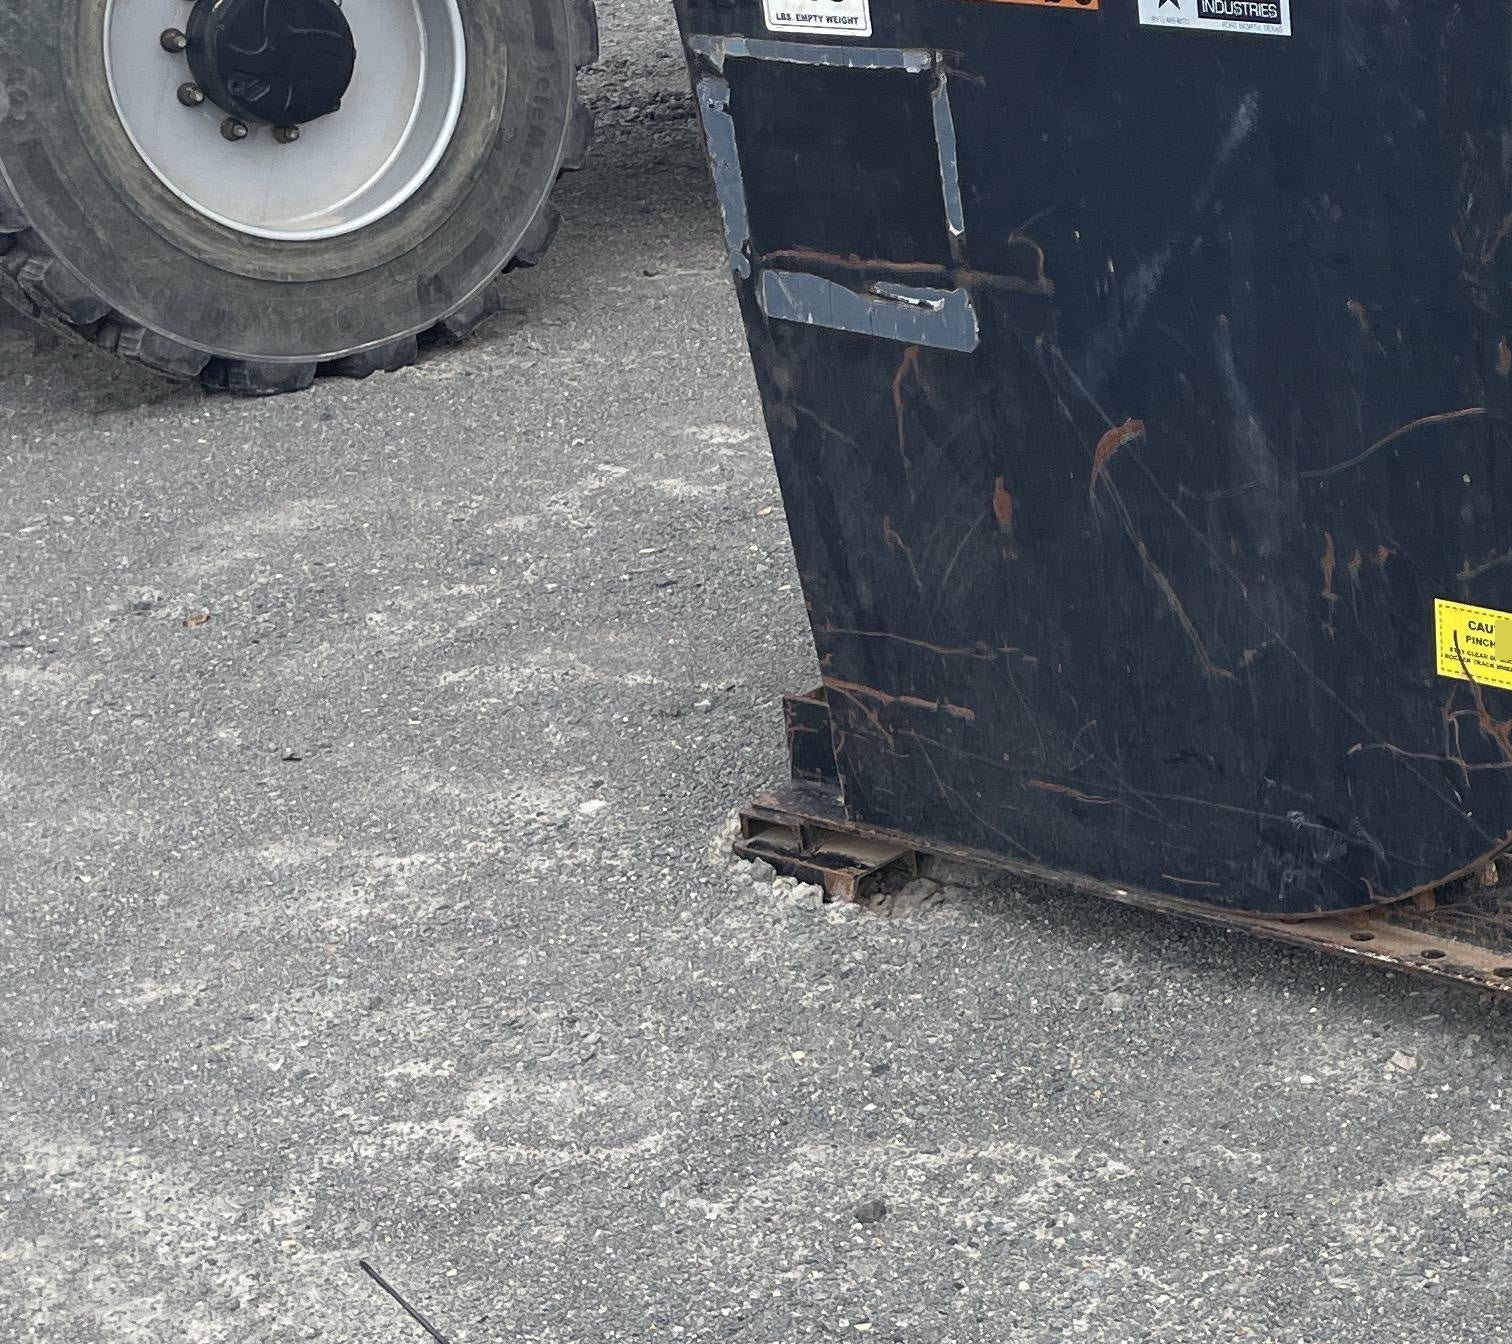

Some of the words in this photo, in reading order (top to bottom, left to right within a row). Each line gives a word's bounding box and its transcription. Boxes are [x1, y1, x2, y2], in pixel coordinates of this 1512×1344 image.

[1201, 0, 1277, 18] INDUSTRIES
[796, 13, 823, 23] EMPTY
[826, 16, 859, 25] WEIGHT
